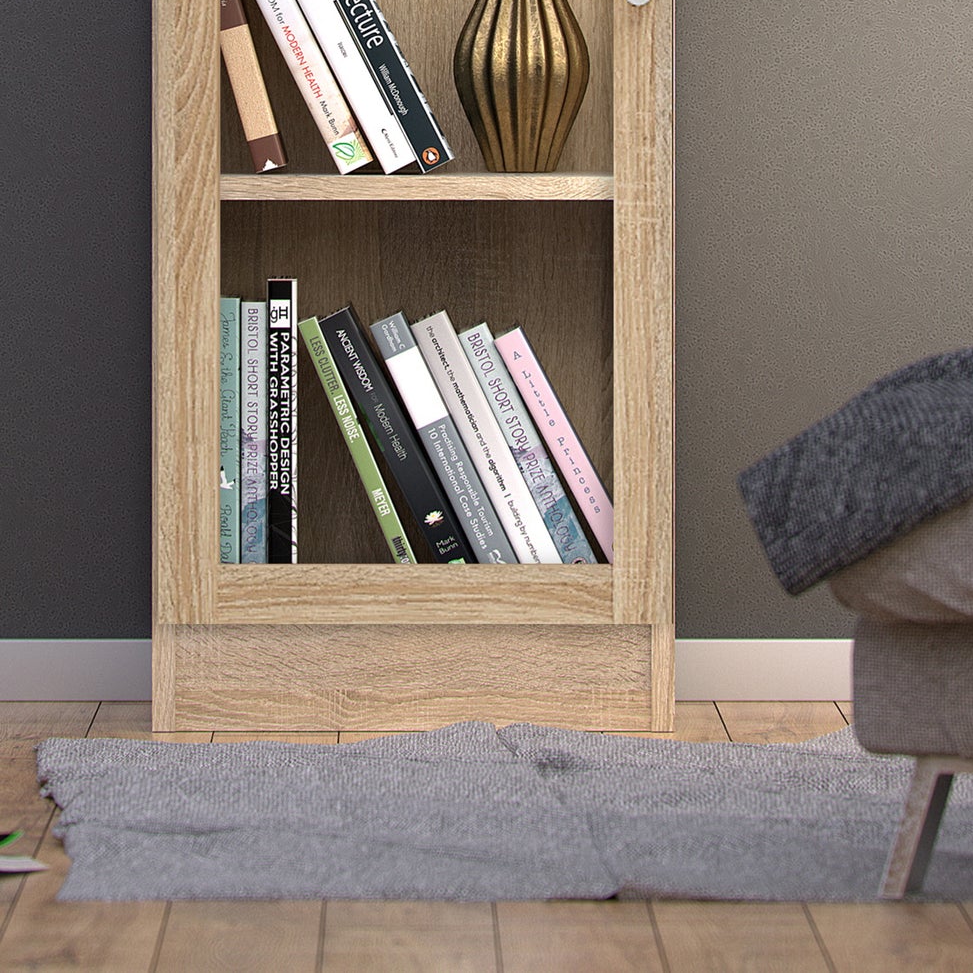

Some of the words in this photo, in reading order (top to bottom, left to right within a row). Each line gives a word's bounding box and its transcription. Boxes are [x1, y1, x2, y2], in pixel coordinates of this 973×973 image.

[275, 10, 286, 25] for
[281, 25, 307, 66] MODERN
[302, 66, 323, 99] HEALTH
[319, 100, 333, 118] Mark
[328, 118, 340, 135] Bunn
[378, 63, 393, 85] William
[389, 83, 409, 116] McDonough
[220, 312, 236, 348] James
[247, 308, 258, 355] BRISTOL
[270, 332, 278, 372] WITH
[220, 368, 233, 383] the
[247, 358, 258, 397] SHORT
[280, 332, 290, 433] PARAMETRIC
[310, 336, 325, 356] LESS
[318, 357, 340, 395] CLUTTER.
[333, 395, 350, 416] LESS
[342, 415, 360, 443] NOISE.
[336, 329, 358, 361] ANCIENT
[353, 361, 373, 392] WISDOM
[374, 403, 394, 435] Modern
[389, 433, 408, 461] Health
[220, 389, 236, 421] Giant
[247, 401, 258, 443] STORY
[426, 326, 435, 338] the
[447, 369, 456, 382] the
[452, 382, 479, 433] mathematician
[476, 431, 487, 447] and
[482, 446, 491, 458] the
[488, 458, 507, 491] algorithm
[220, 424, 236, 457] Peach
[270, 377, 278, 490] GRASSHOPPER
[428, 427, 439, 440] 10
[467, 332, 495, 377] BRISTOL
[488, 377, 515, 414] SHORT
[505, 415, 531, 452] STORY
[523, 452, 546, 484] PRIZE
[536, 485, 576, 552] ANTHOLOGY
[513, 351, 522, 360] A
[557, 436, 601, 514] Princess
[247, 444, 258, 474] PRIZE
[280, 438, 290, 495] DESIGN
[433, 440, 463, 495] International
[438, 424, 459, 461] Practising
[455, 461, 480, 506] Responsible
[477, 506, 494, 537] Tourism
[246, 479, 258, 553] ANTHOLOGY
[371, 488, 391, 517] MEYER
[459, 495, 473, 518] Case
[507, 499, 523, 527] building
[518, 523, 528, 536] by
[436, 536, 456, 548] Mark
[439, 542, 459, 555] Bunn
[470, 518, 487, 549] Studies
